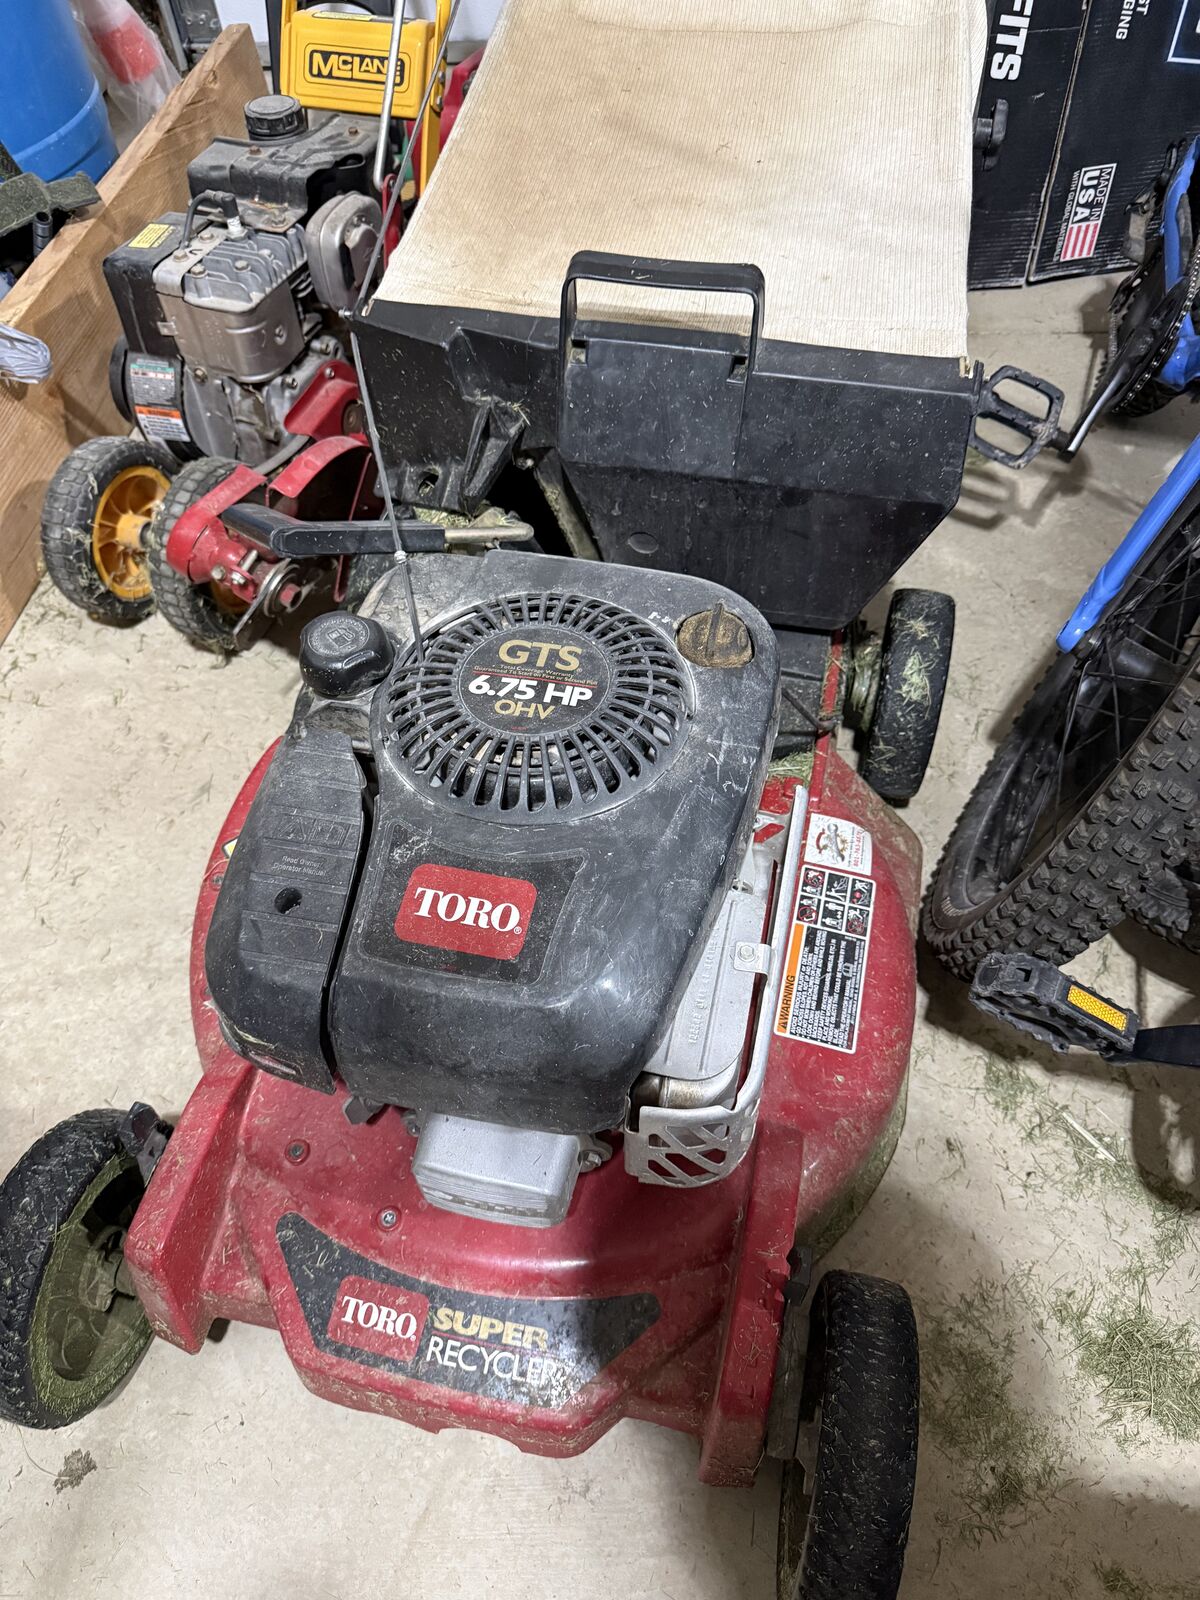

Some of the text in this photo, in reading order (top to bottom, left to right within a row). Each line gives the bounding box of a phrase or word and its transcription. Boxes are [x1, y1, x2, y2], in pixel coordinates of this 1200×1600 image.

[1070, 170, 1080, 191] WITH
[1073, 170, 1100, 222] USA
[1089, 168, 1112, 220] MADE IN
[499, 640, 582, 671] GTS
[468, 675, 593, 707] 6.75 HP
[494, 699, 556, 720] OHV
[414, 887, 520, 932] TORO
[780, 975, 795, 1022] WARNING
[341, 1296, 549, 1349] TORO SUPER
